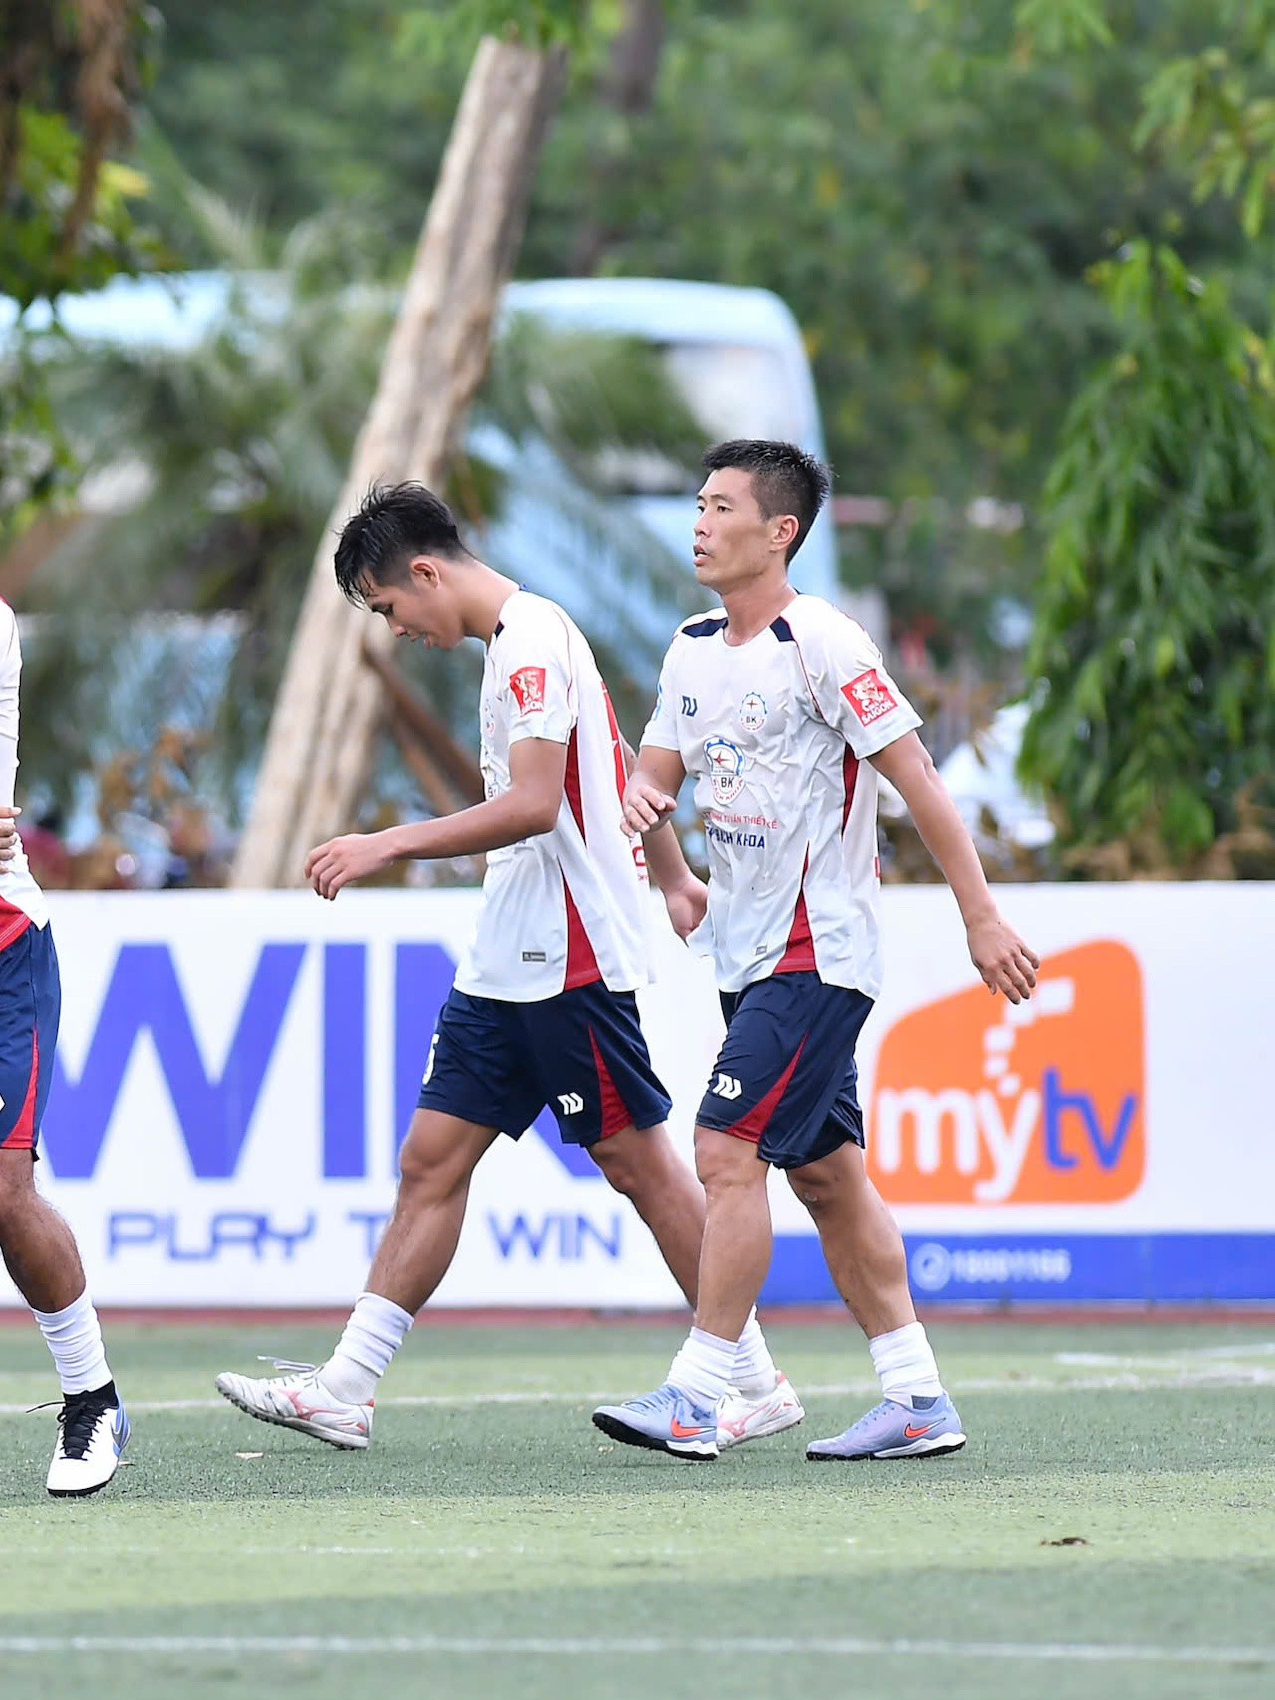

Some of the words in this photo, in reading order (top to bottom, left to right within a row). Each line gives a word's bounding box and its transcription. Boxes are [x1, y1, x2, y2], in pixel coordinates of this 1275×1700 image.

[861, 699, 894, 724] SAIGON
[720, 776, 735, 788] BK
[875, 1065, 1138, 1203] mytv
[107, 1209, 316, 1260] PLAY
[486, 1209, 622, 1260] WIN
